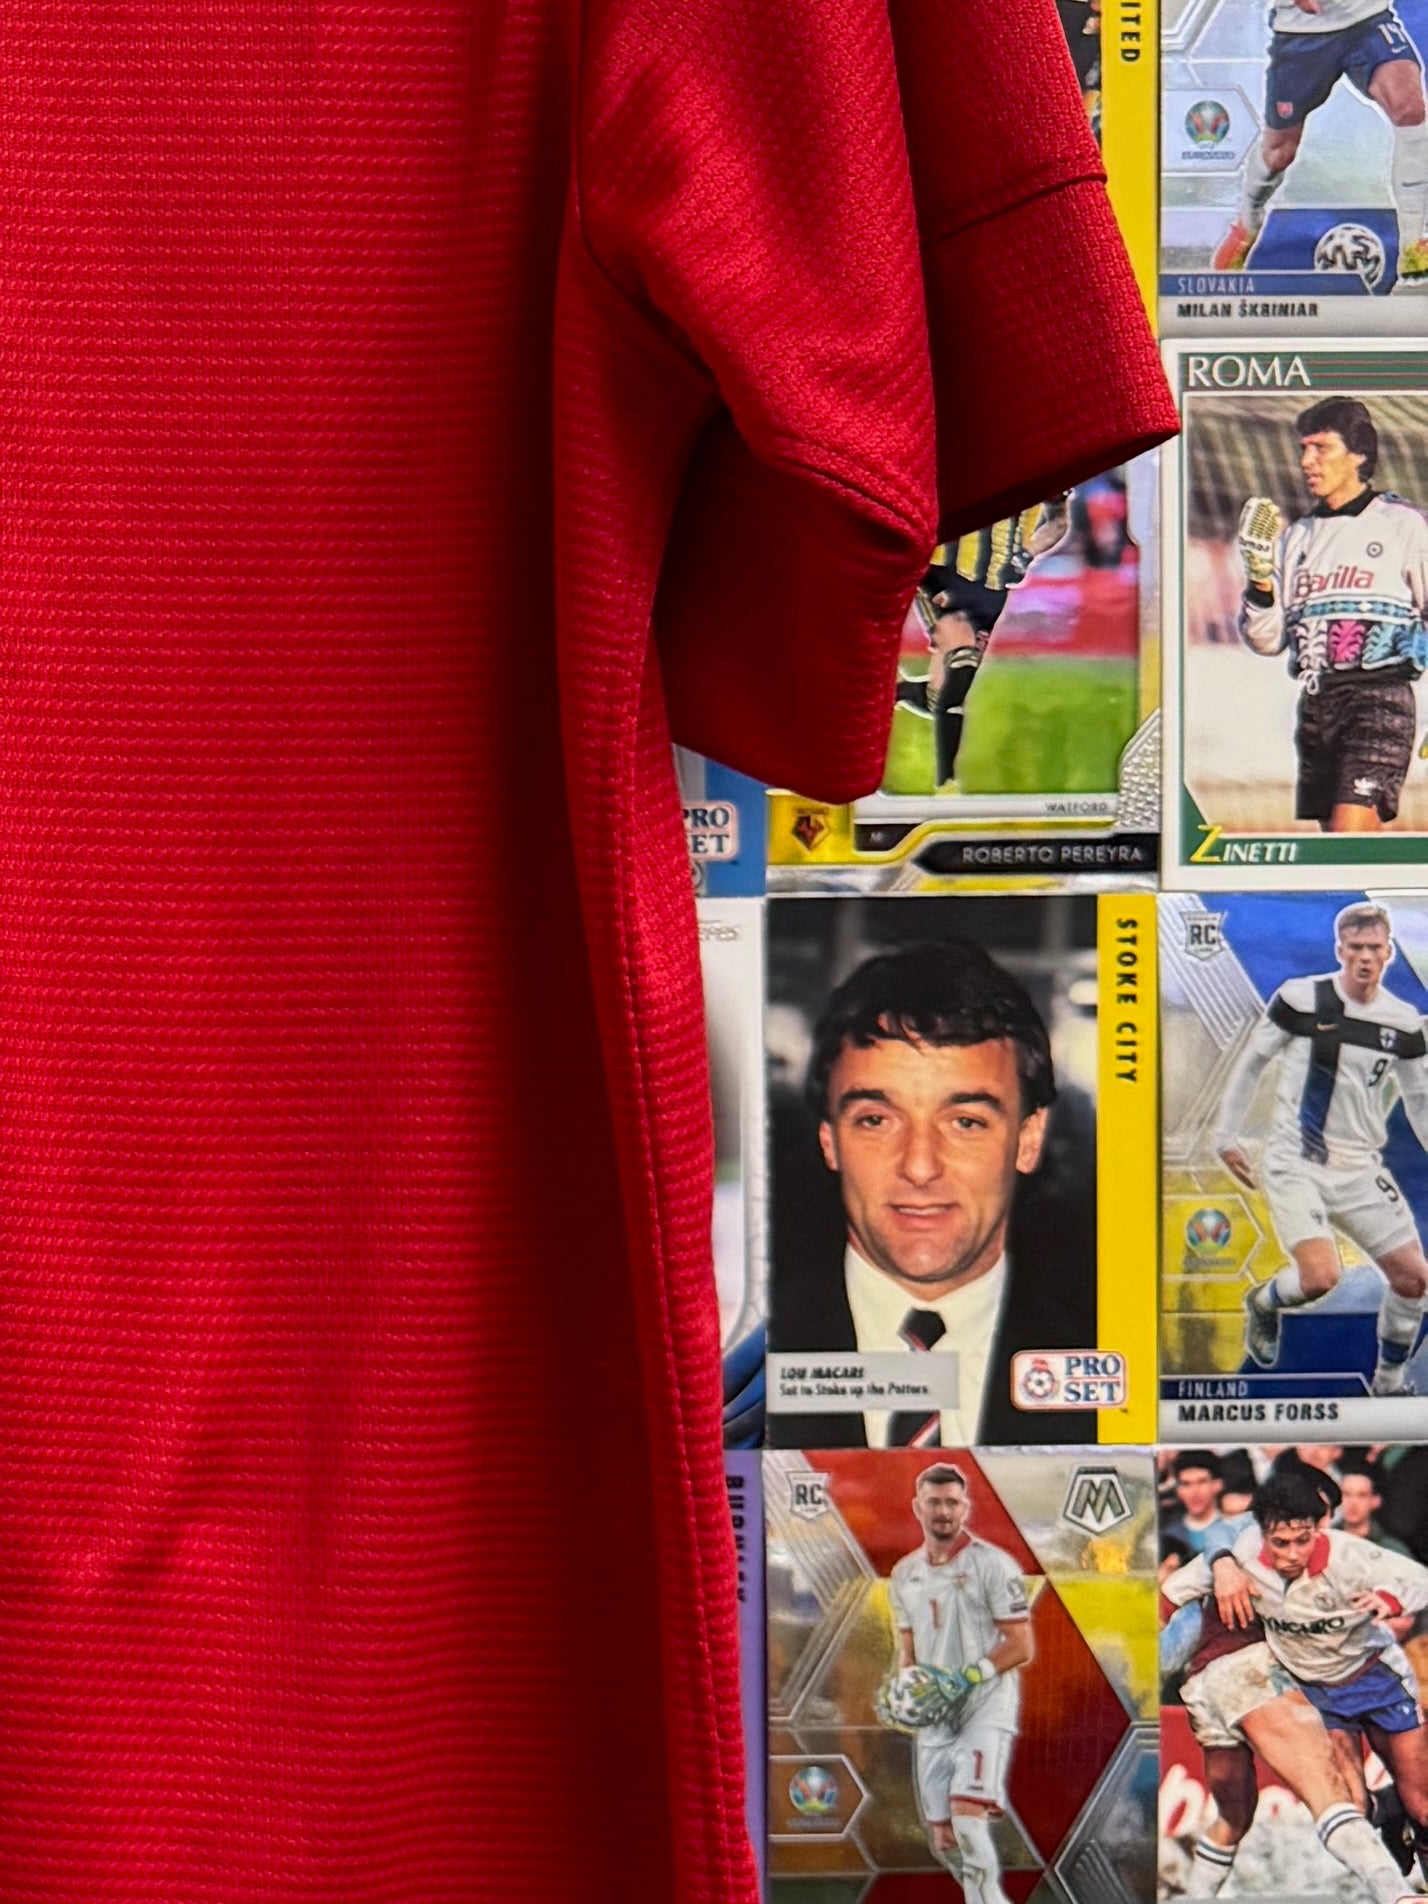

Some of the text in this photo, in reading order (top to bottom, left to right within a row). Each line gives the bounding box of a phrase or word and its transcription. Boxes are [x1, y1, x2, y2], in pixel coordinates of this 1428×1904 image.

[1178, 275, 1255, 294] SLOVAKIA
[1177, 299, 1318, 318] MILAN ŠKRINIAR
[1188, 356, 1310, 388] ROMA
[1294, 567, 1375, 600] Barilla
[1044, 801, 1108, 813] WATFORD
[961, 844, 1142, 863] ROBERTO PEREYRA
[1190, 824, 1298, 864] ZINETTI
[1115, 918, 1138, 1083] STOKE CITY
[1178, 1380, 1249, 1398] FINLAND
[1178, 1403, 1340, 1422] MARCUS FORSS
